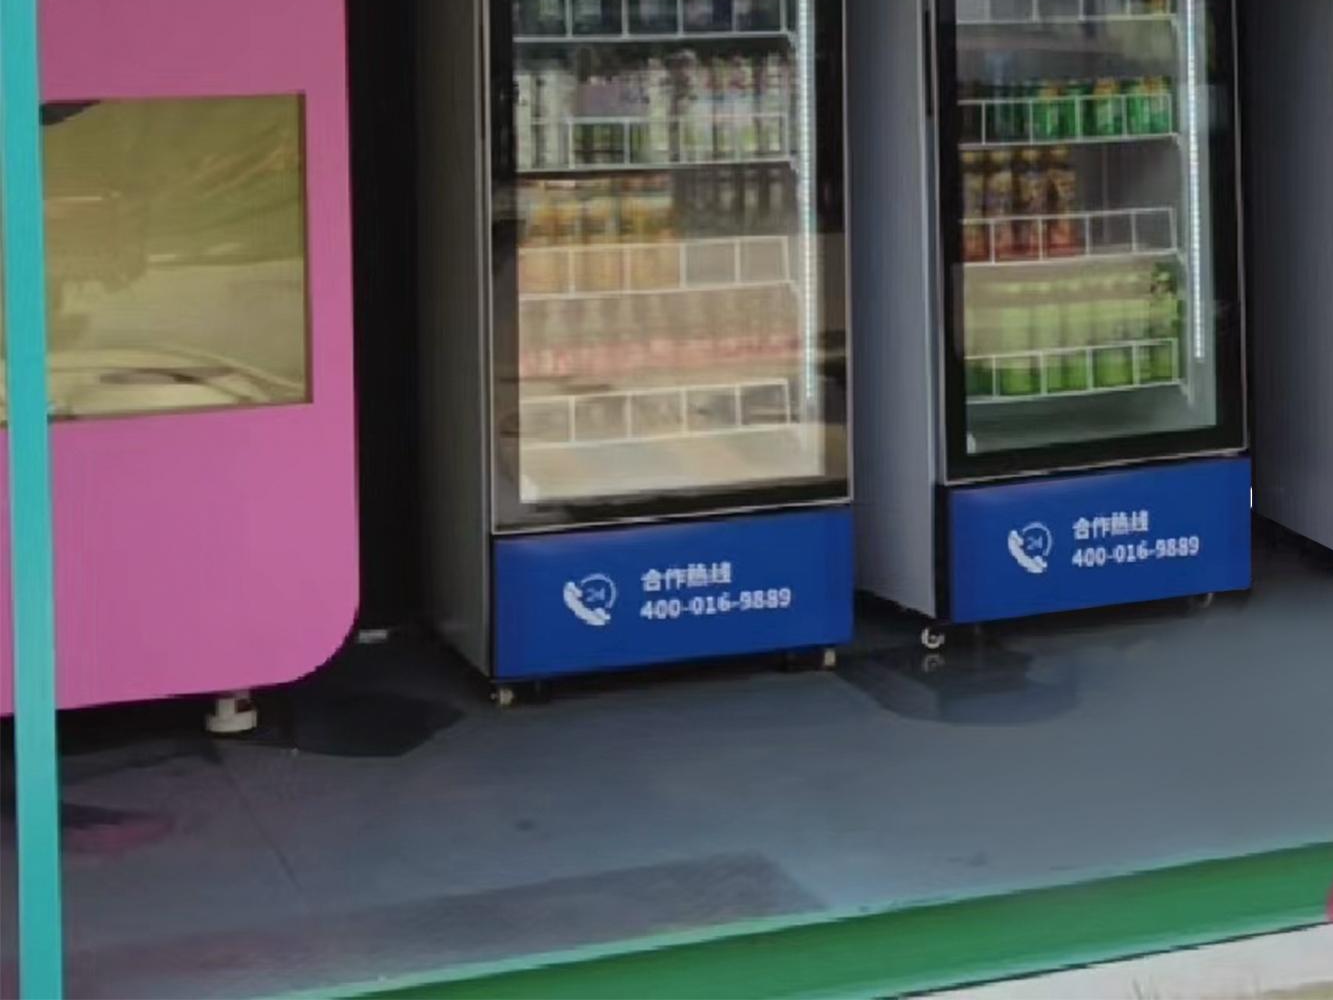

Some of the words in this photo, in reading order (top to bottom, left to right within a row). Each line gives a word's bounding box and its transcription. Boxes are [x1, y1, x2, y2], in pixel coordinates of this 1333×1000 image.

[1072, 510, 1149, 540] 合作热线
[1072, 535, 1200, 568] 400-016-9889
[640, 561, 732, 592] 合作热线
[640, 587, 792, 620] 400-016-9889
